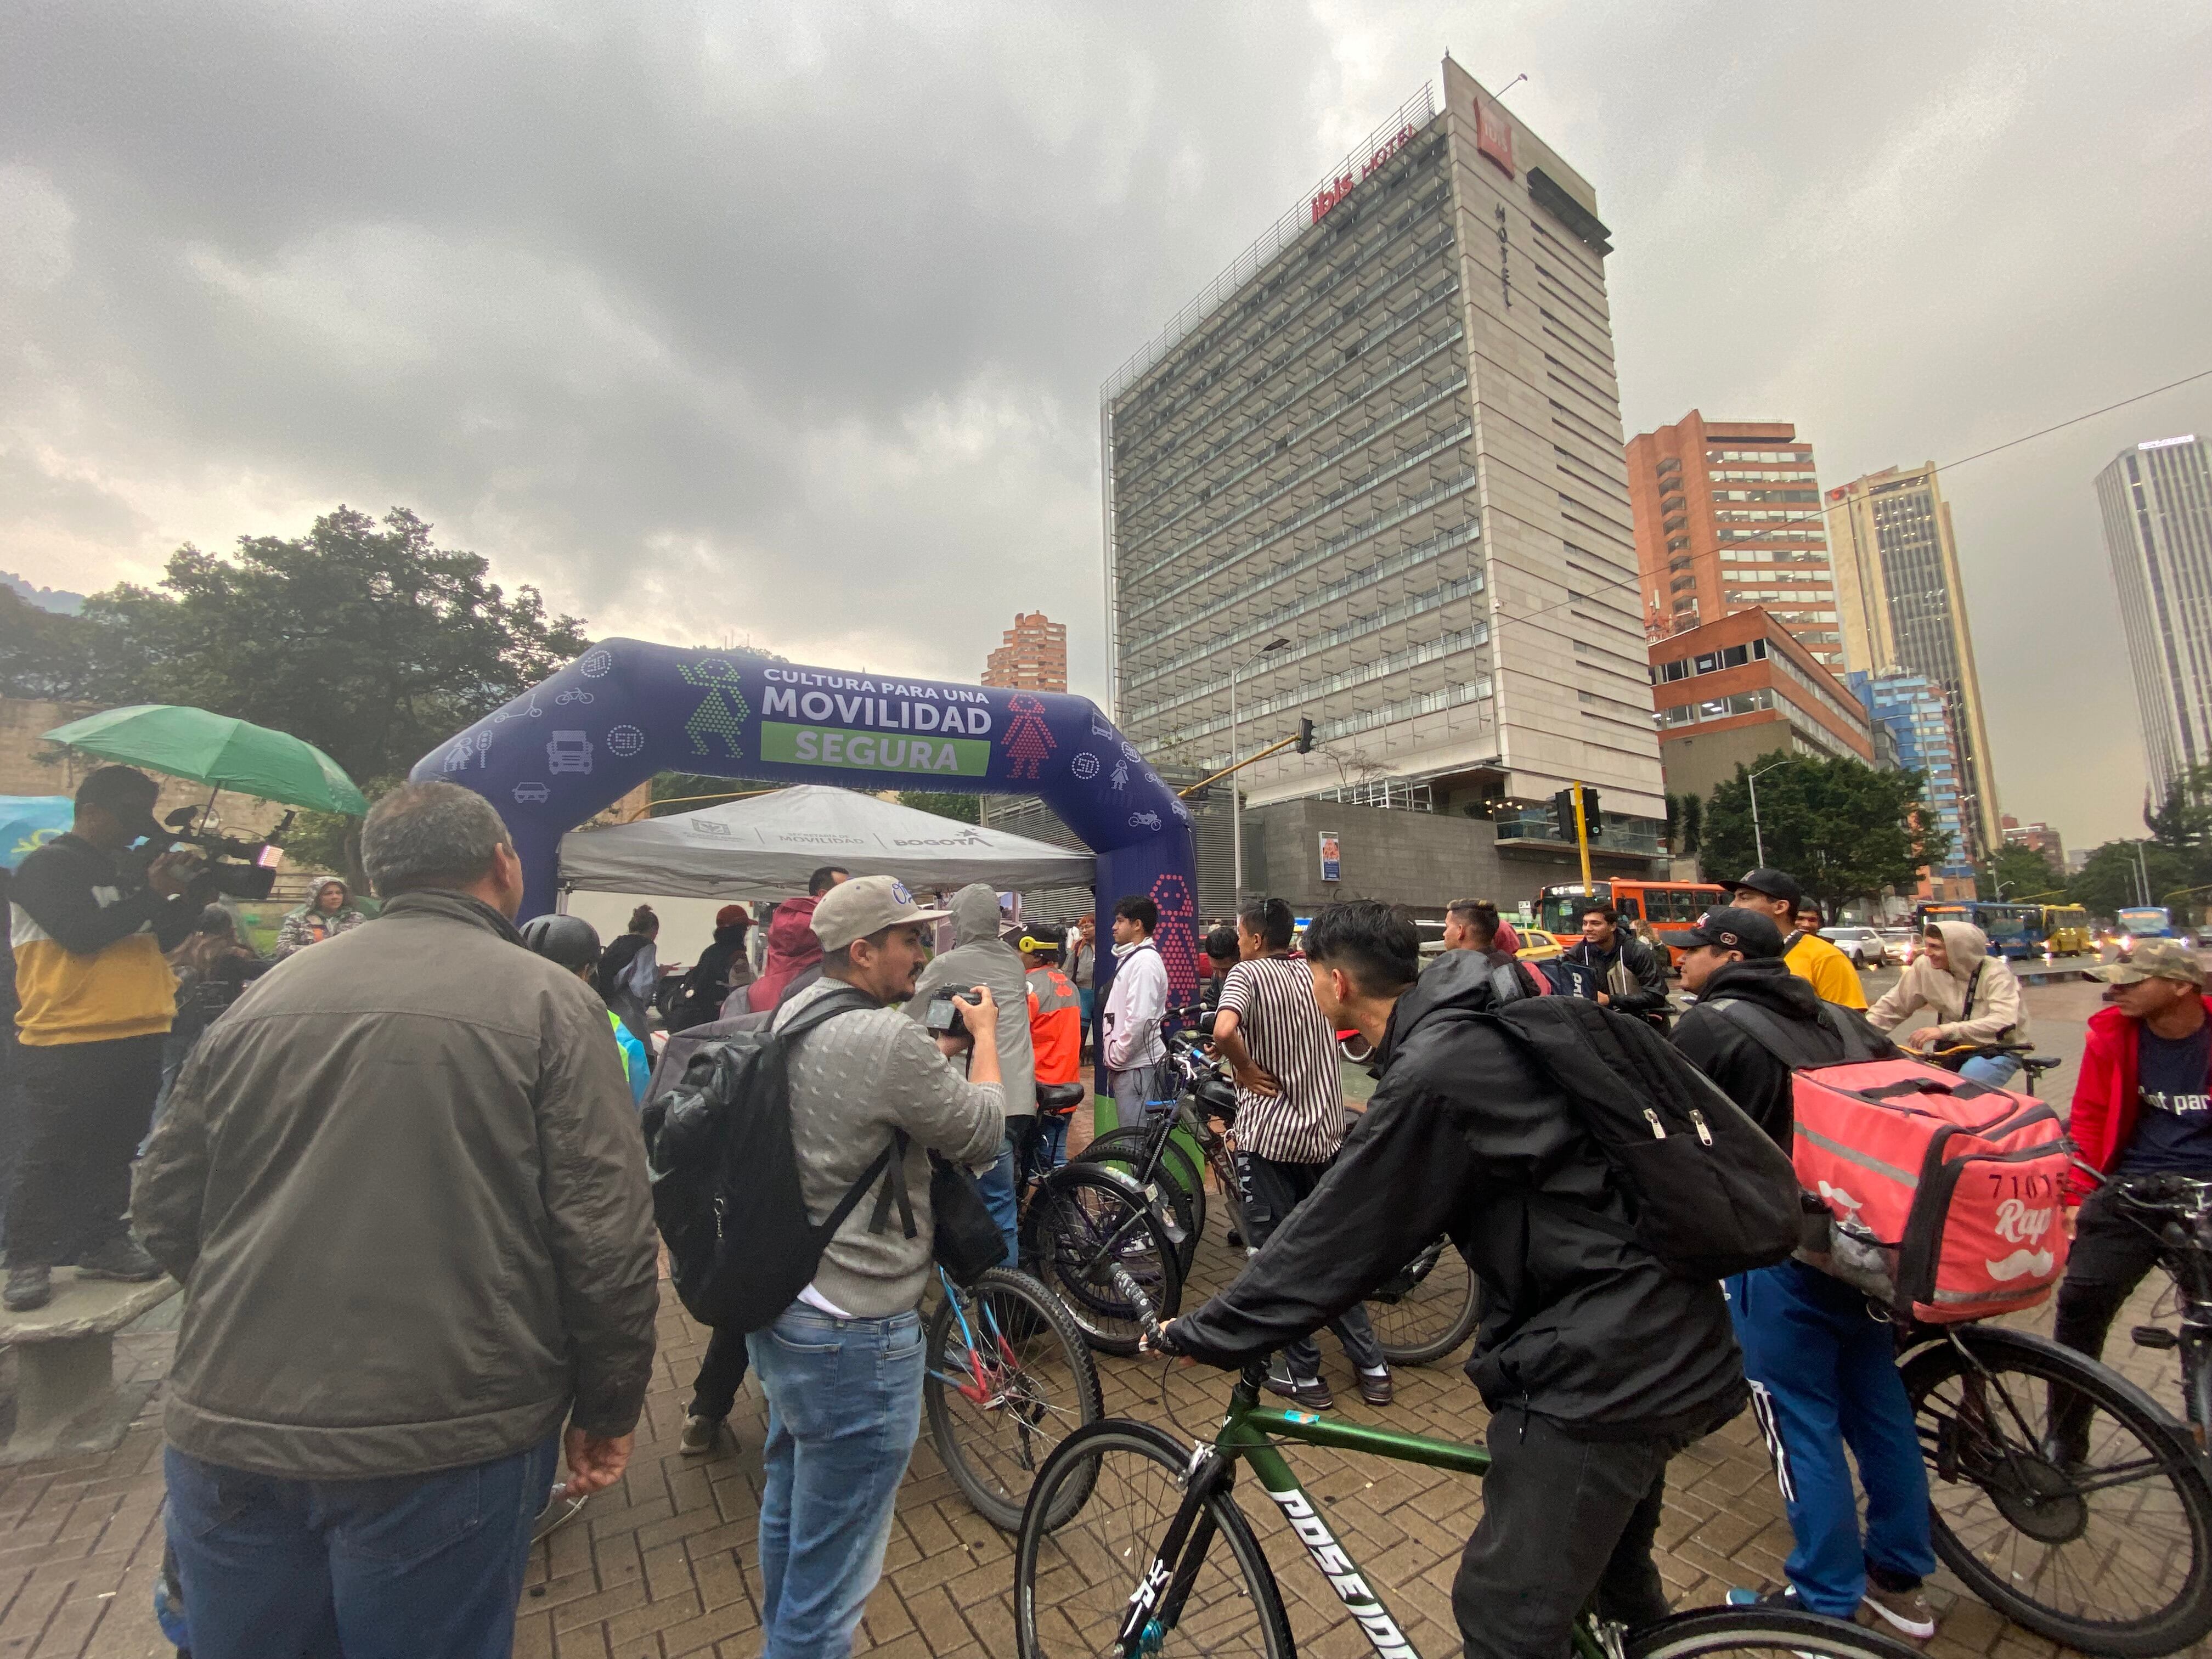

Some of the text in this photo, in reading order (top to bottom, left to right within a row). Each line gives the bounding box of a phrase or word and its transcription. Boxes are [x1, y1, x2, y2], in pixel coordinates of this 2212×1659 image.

[1311, 122, 1419, 224] ibis HOTEL
[763, 668, 990, 704] CULTURA PARA UNA
[761, 685, 992, 735] MOVILIDAD
[795, 731, 958, 771] SEGURA
[778, 835, 865, 844] MOVILIDAD
